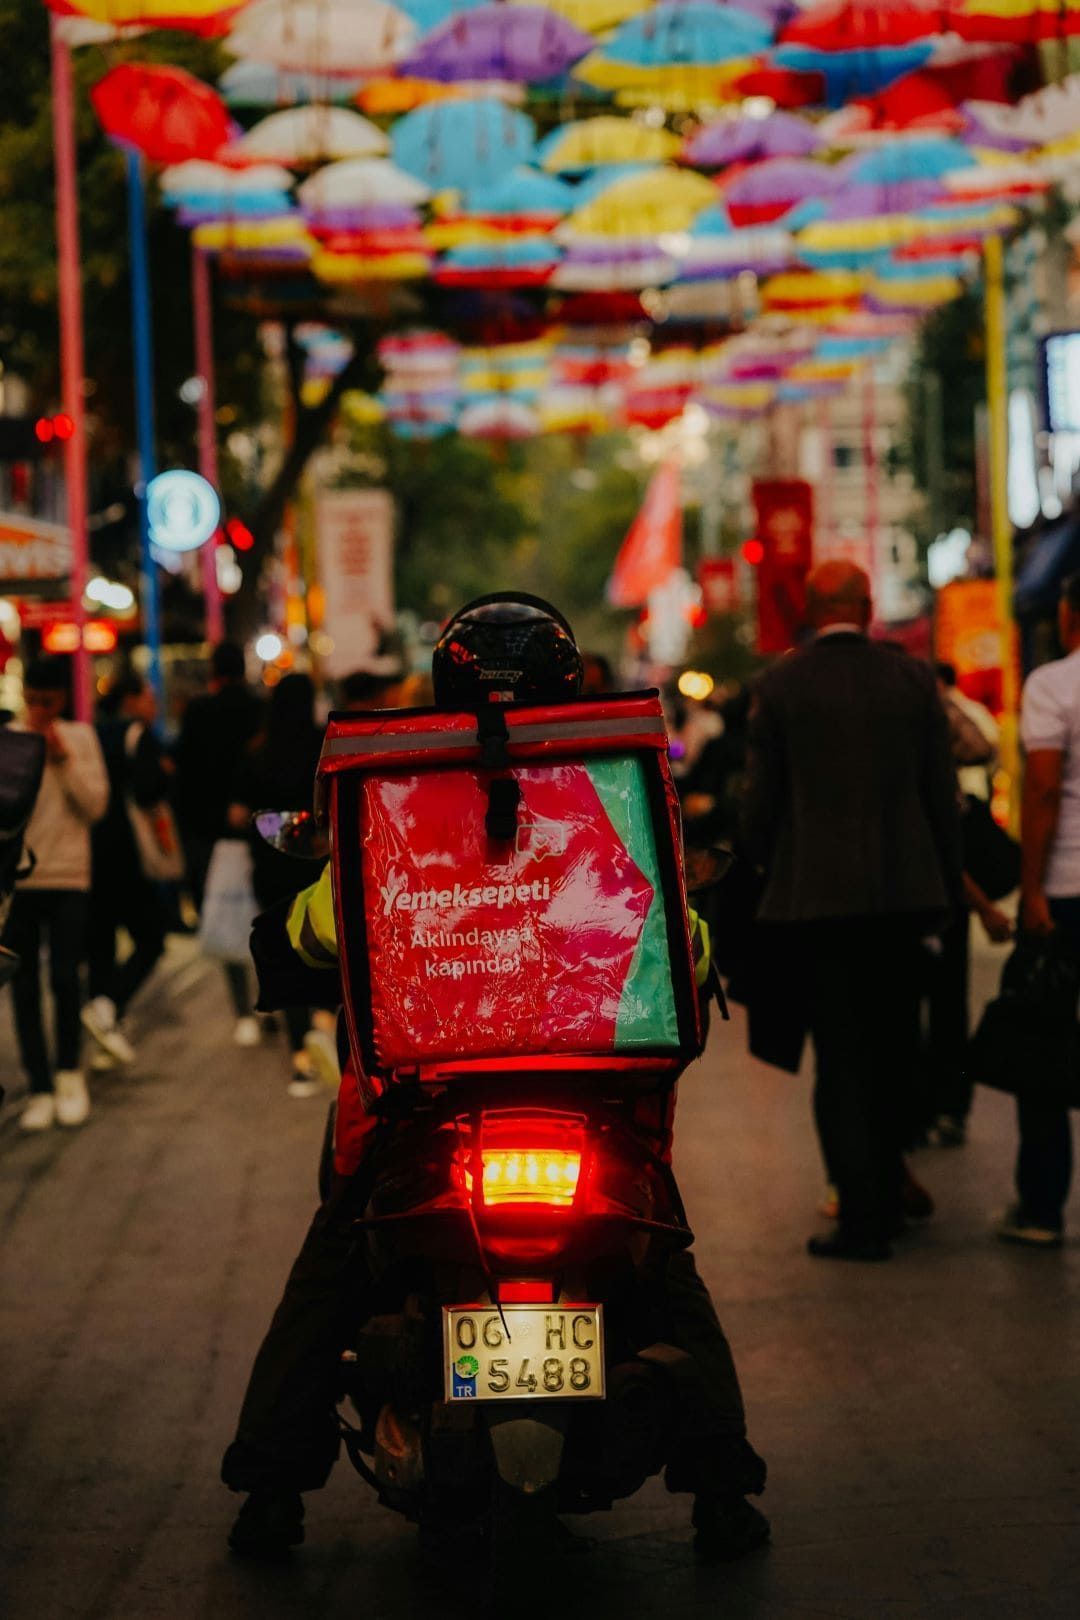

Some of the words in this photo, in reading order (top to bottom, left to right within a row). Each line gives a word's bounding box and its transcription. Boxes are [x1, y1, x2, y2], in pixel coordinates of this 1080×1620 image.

[380, 877, 550, 916] Yemeksepeti
[456, 1316, 503, 1350] 06
[545, 1315, 594, 1350] HC
[456, 1386, 473, 1397] TR
[488, 1357, 591, 1393] 5488
